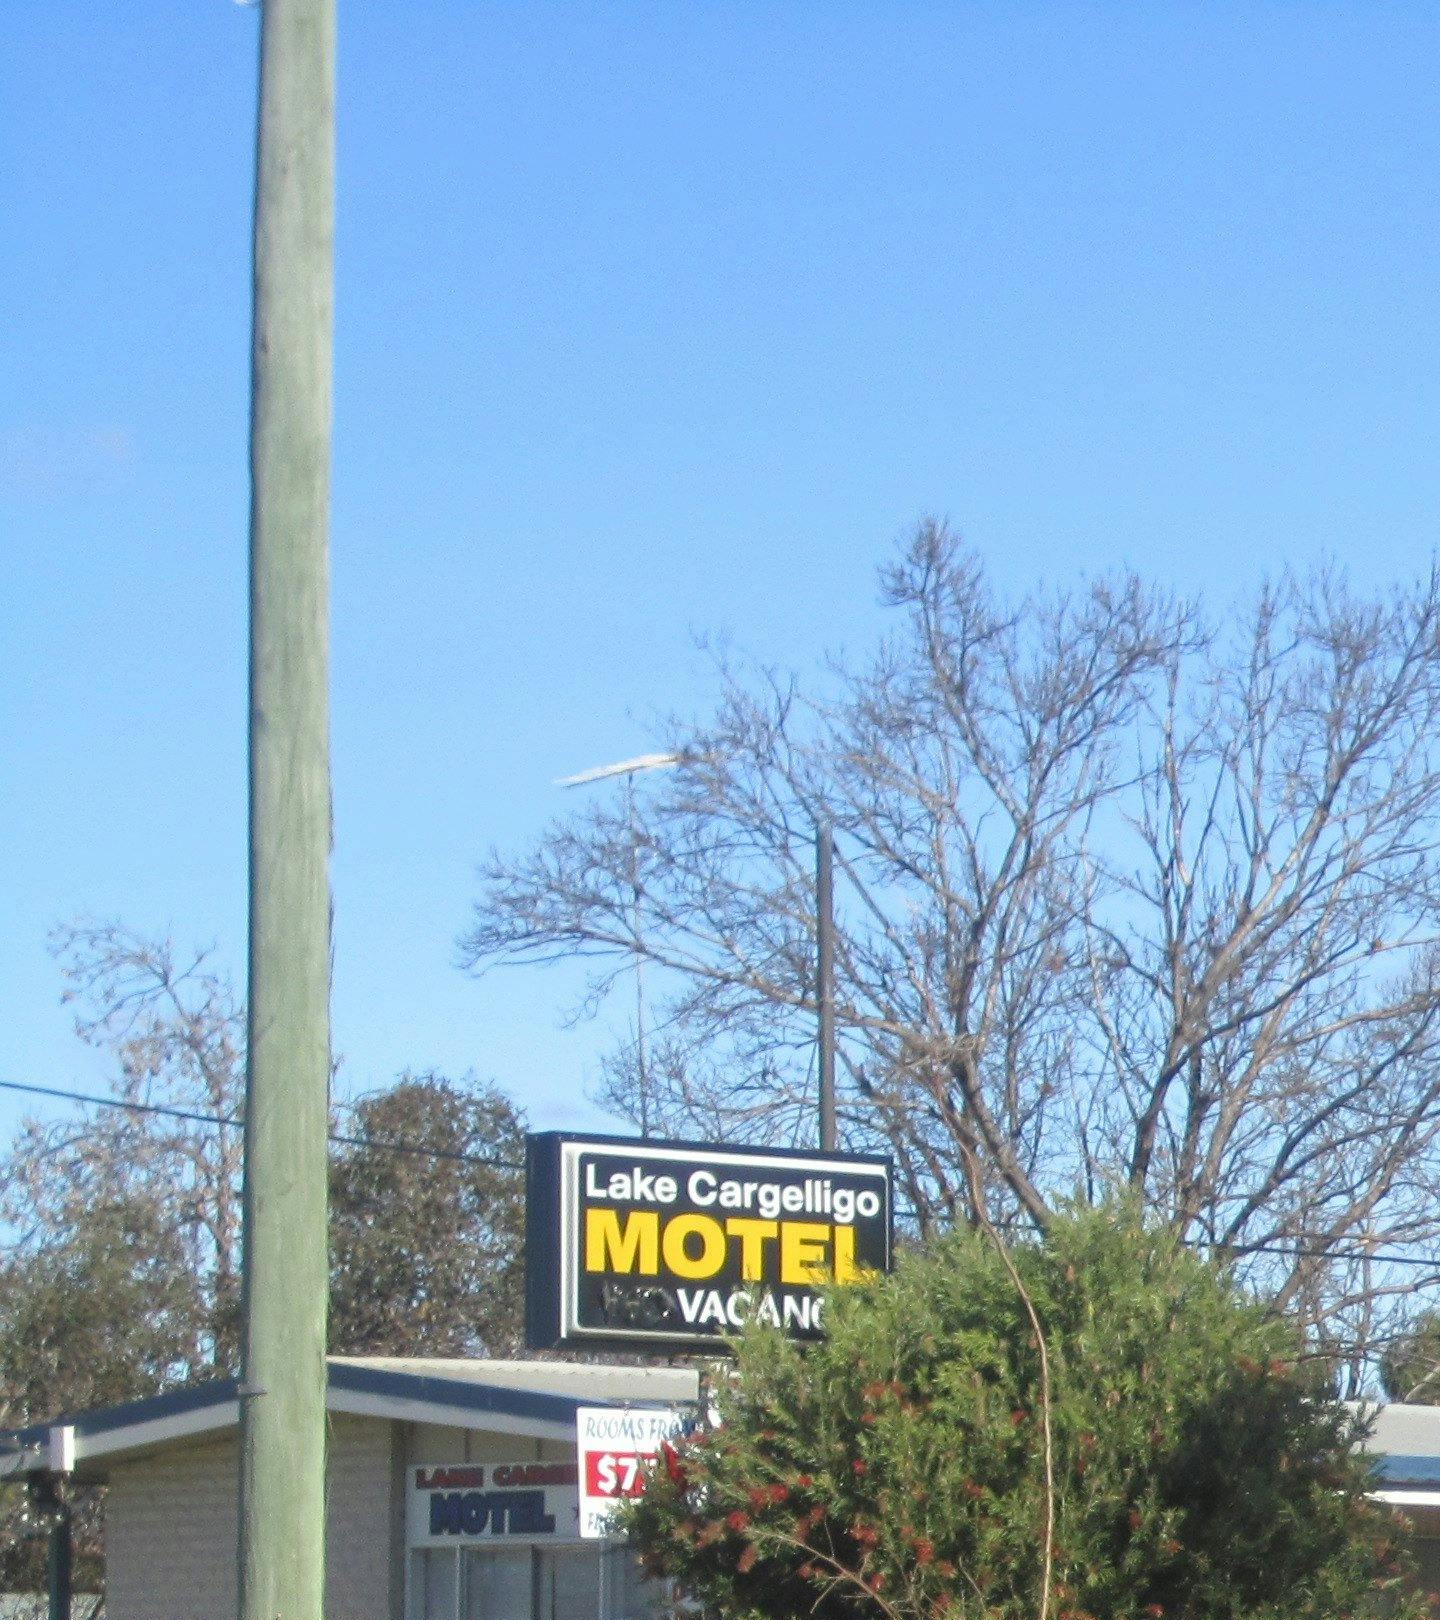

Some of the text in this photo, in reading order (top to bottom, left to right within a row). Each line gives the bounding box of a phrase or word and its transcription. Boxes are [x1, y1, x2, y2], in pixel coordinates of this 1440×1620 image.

[585, 1163, 881, 1223] Lake Cargelligo
[585, 1208, 880, 1286] MOTEL
[585, 1417, 645, 1440] ROOMS
[596, 1453, 659, 1495] $7
[430, 1490, 556, 1535] MOTEL
